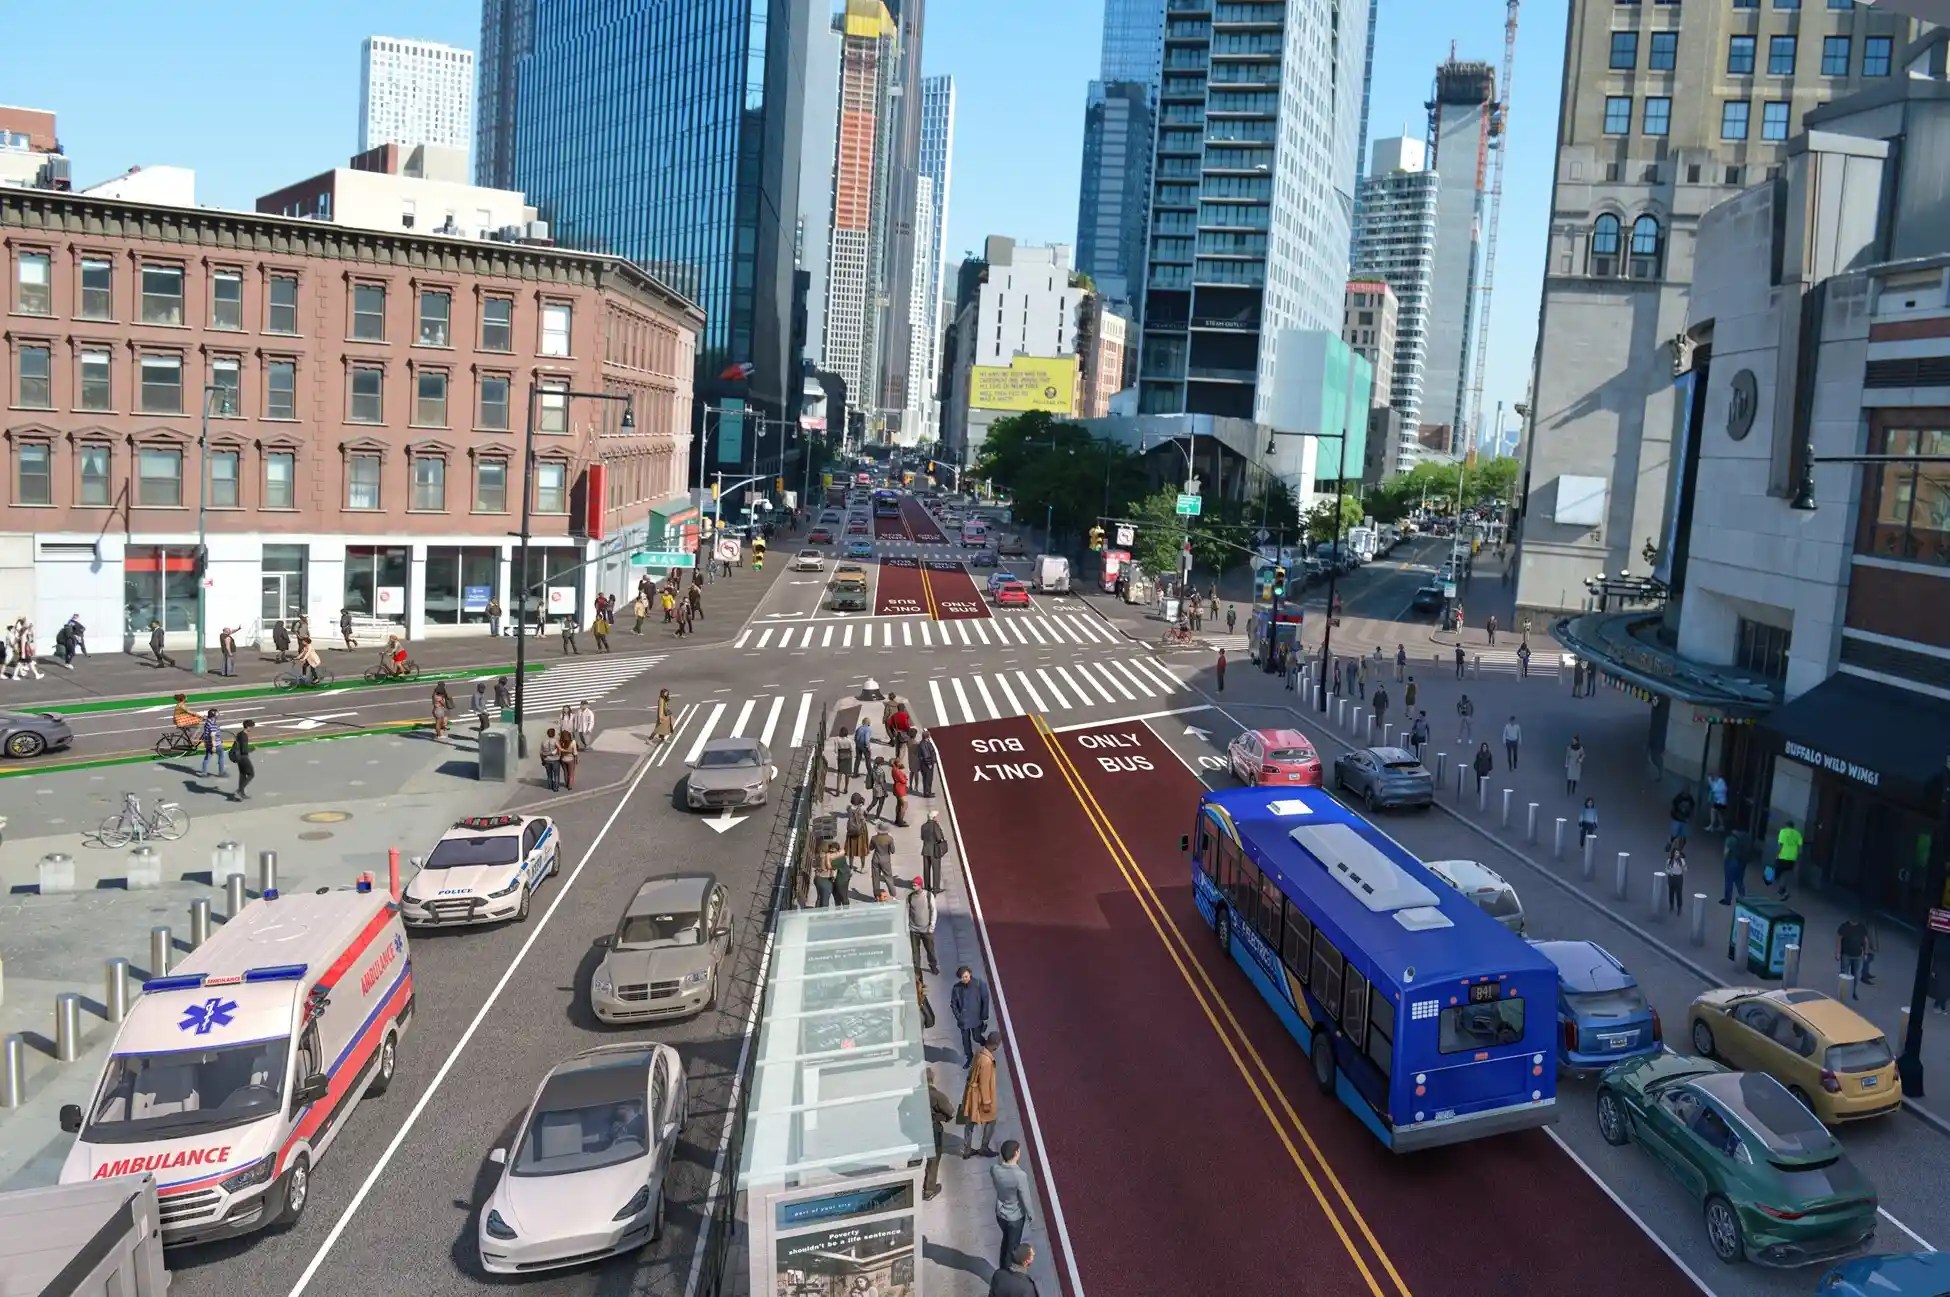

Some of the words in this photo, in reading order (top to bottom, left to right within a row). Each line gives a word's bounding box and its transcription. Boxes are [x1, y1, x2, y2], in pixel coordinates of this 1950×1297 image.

[971, 738, 1025, 752] BUS
[1078, 733, 1142, 749] ONLY
[1097, 755, 1154, 772] BUS
[1785, 740, 1822, 765] BUFFALO
[1823, 754, 1847, 774] WILD
[1848, 762, 1879, 785] WINGS
[973, 762, 1043, 781] ONLY
[438, 888, 474, 896] POLICE
[361, 942, 396, 997] AMBULANCE
[1476, 985, 1493, 1000] B41
[93, 1146, 231, 1180] AMBULANCE
[788, 1243, 825, 1255] shouldn't
[827, 1240, 838, 1248] be
[847, 1235, 861, 1244] life
[863, 1229, 901, 1240] sentence
[829, 1229, 859, 1240] Poverty
